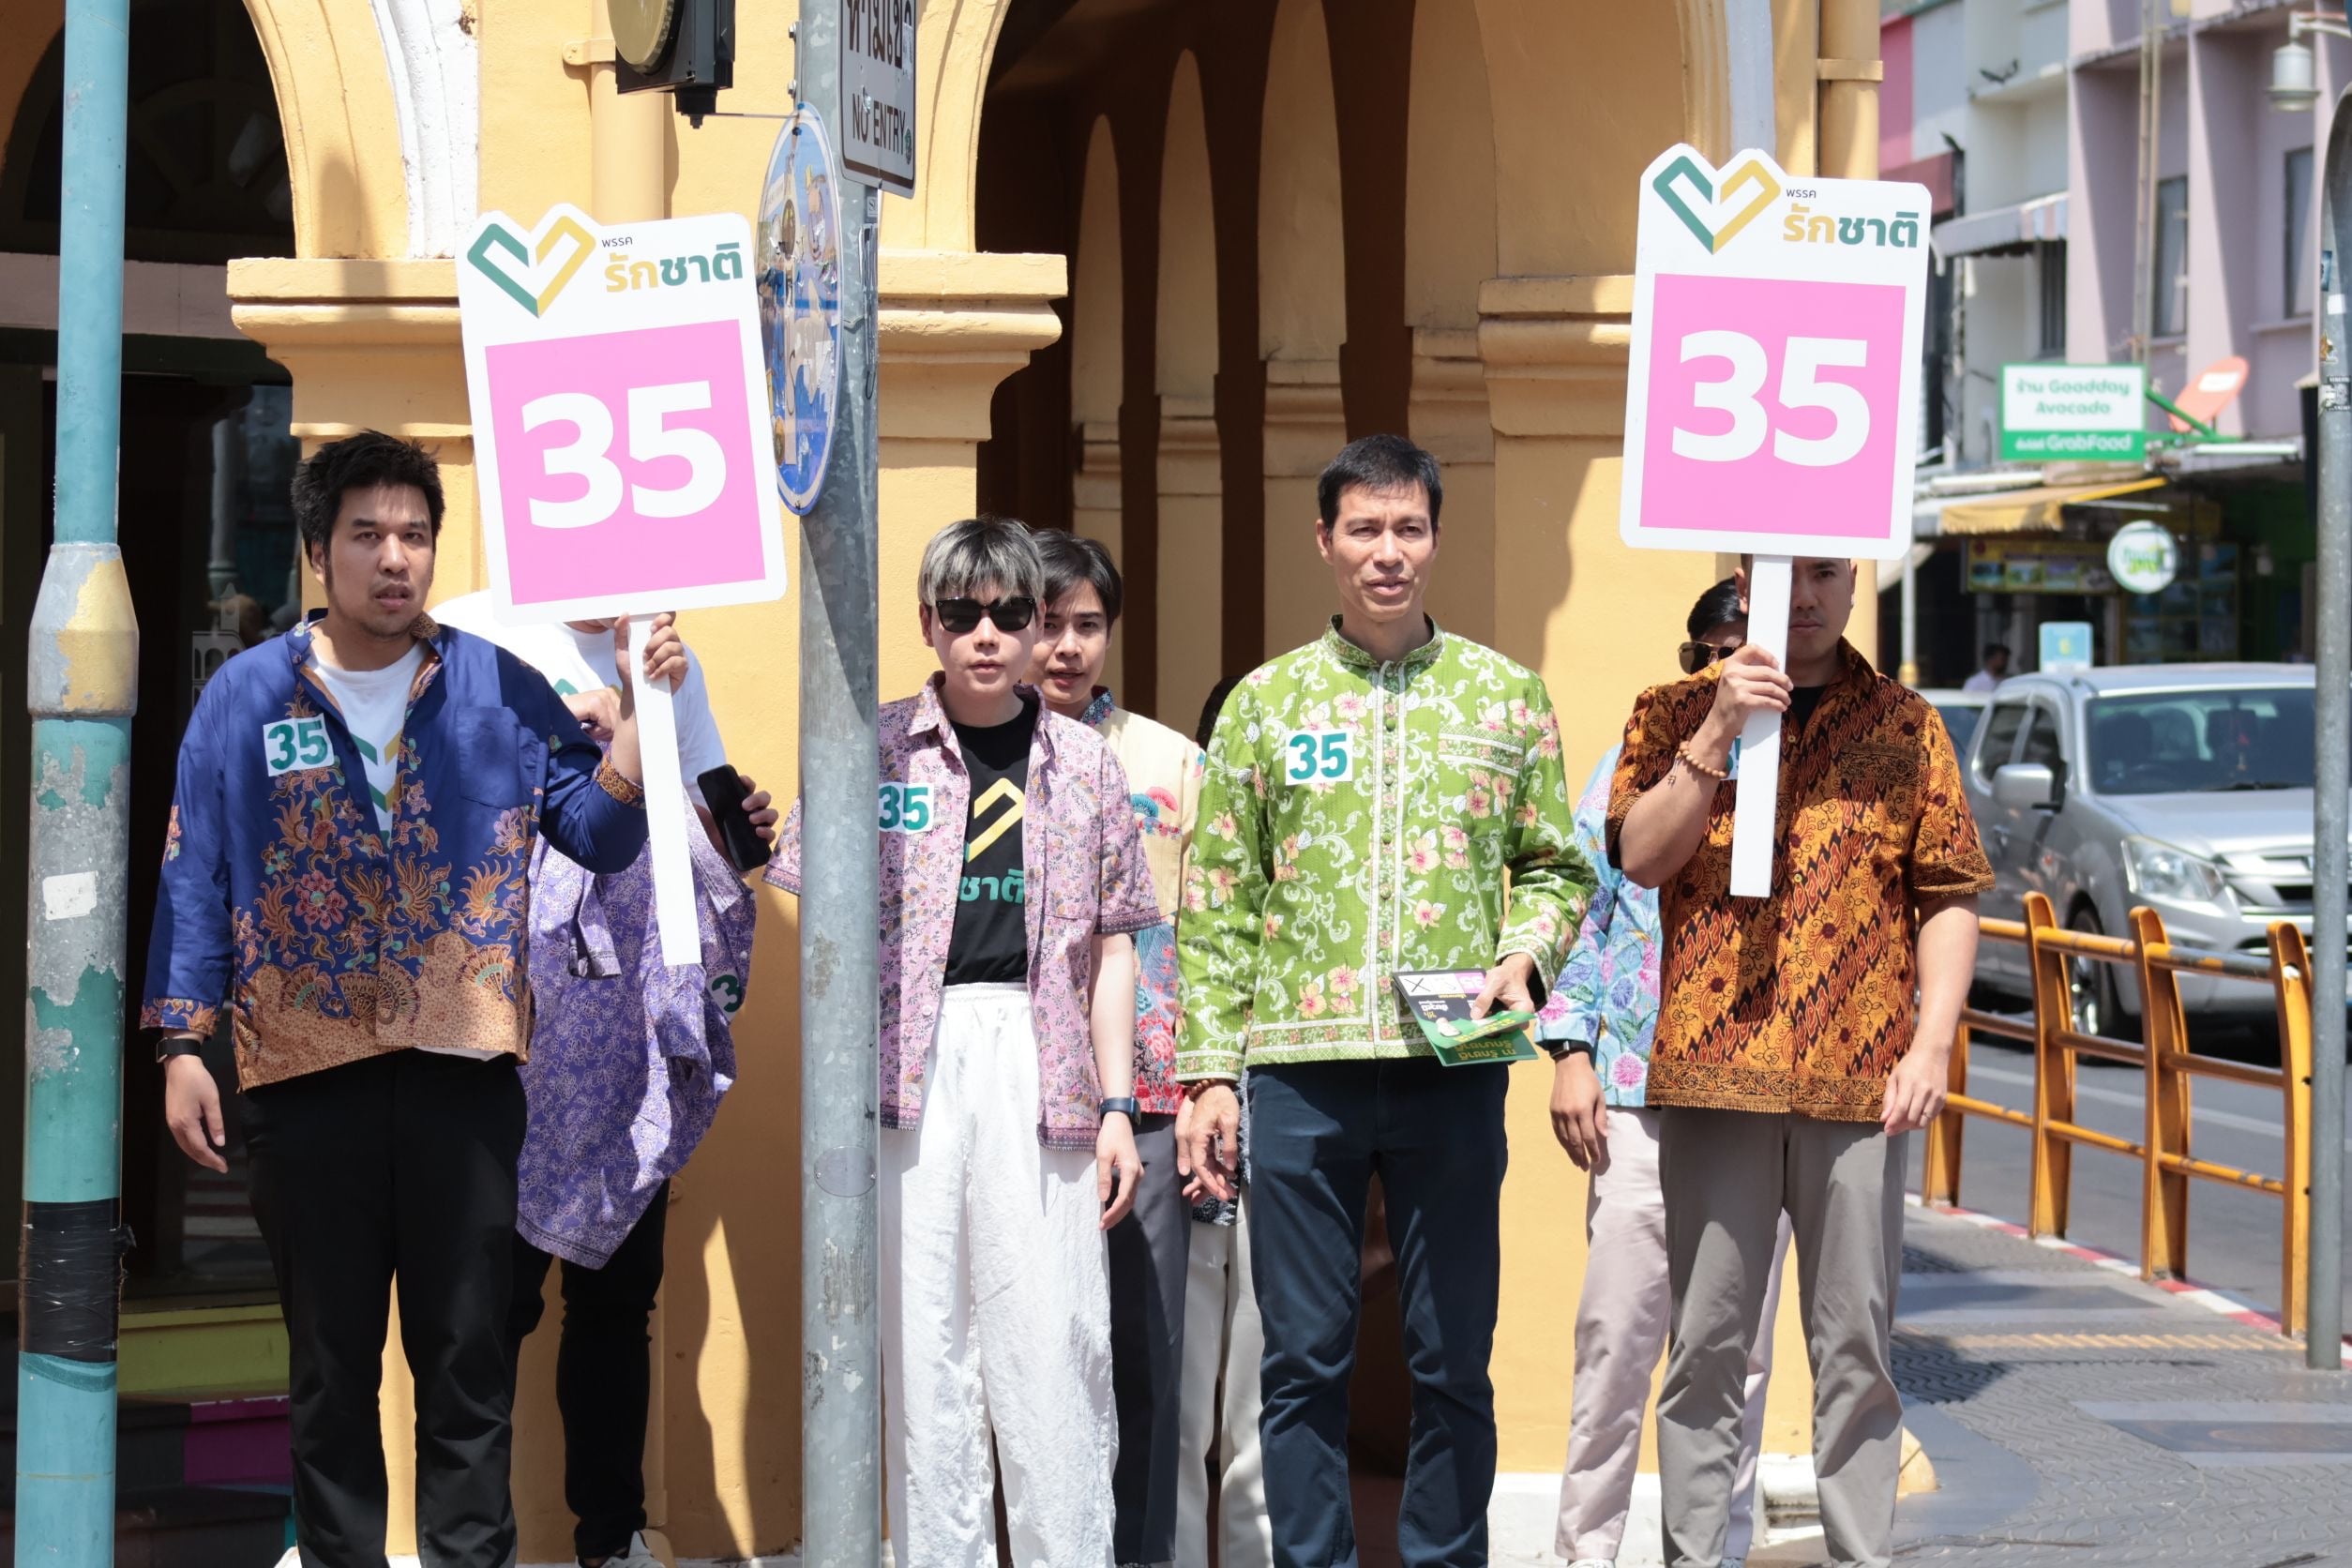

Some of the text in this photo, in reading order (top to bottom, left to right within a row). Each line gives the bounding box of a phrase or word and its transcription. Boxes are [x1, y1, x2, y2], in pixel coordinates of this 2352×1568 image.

[852, 93, 906, 156] NO ENTRY
[1786, 188, 1817, 199] พรรค
[601, 236, 633, 248] พรรค
[1783, 204, 1919, 248] รักชาติ
[604, 242, 743, 293] รักชาติ
[1671, 330, 1871, 466] 35
[2035, 401, 2111, 415] Avocado
[521, 380, 727, 529] 35
[2046, 434, 2133, 451] GrabFood
[267, 720, 327, 770] 35
[1289, 732, 1348, 780] 35
[879, 785, 929, 830] 35
[960, 868, 1024, 903] ชาติ
[712, 974, 743, 1013] 3
